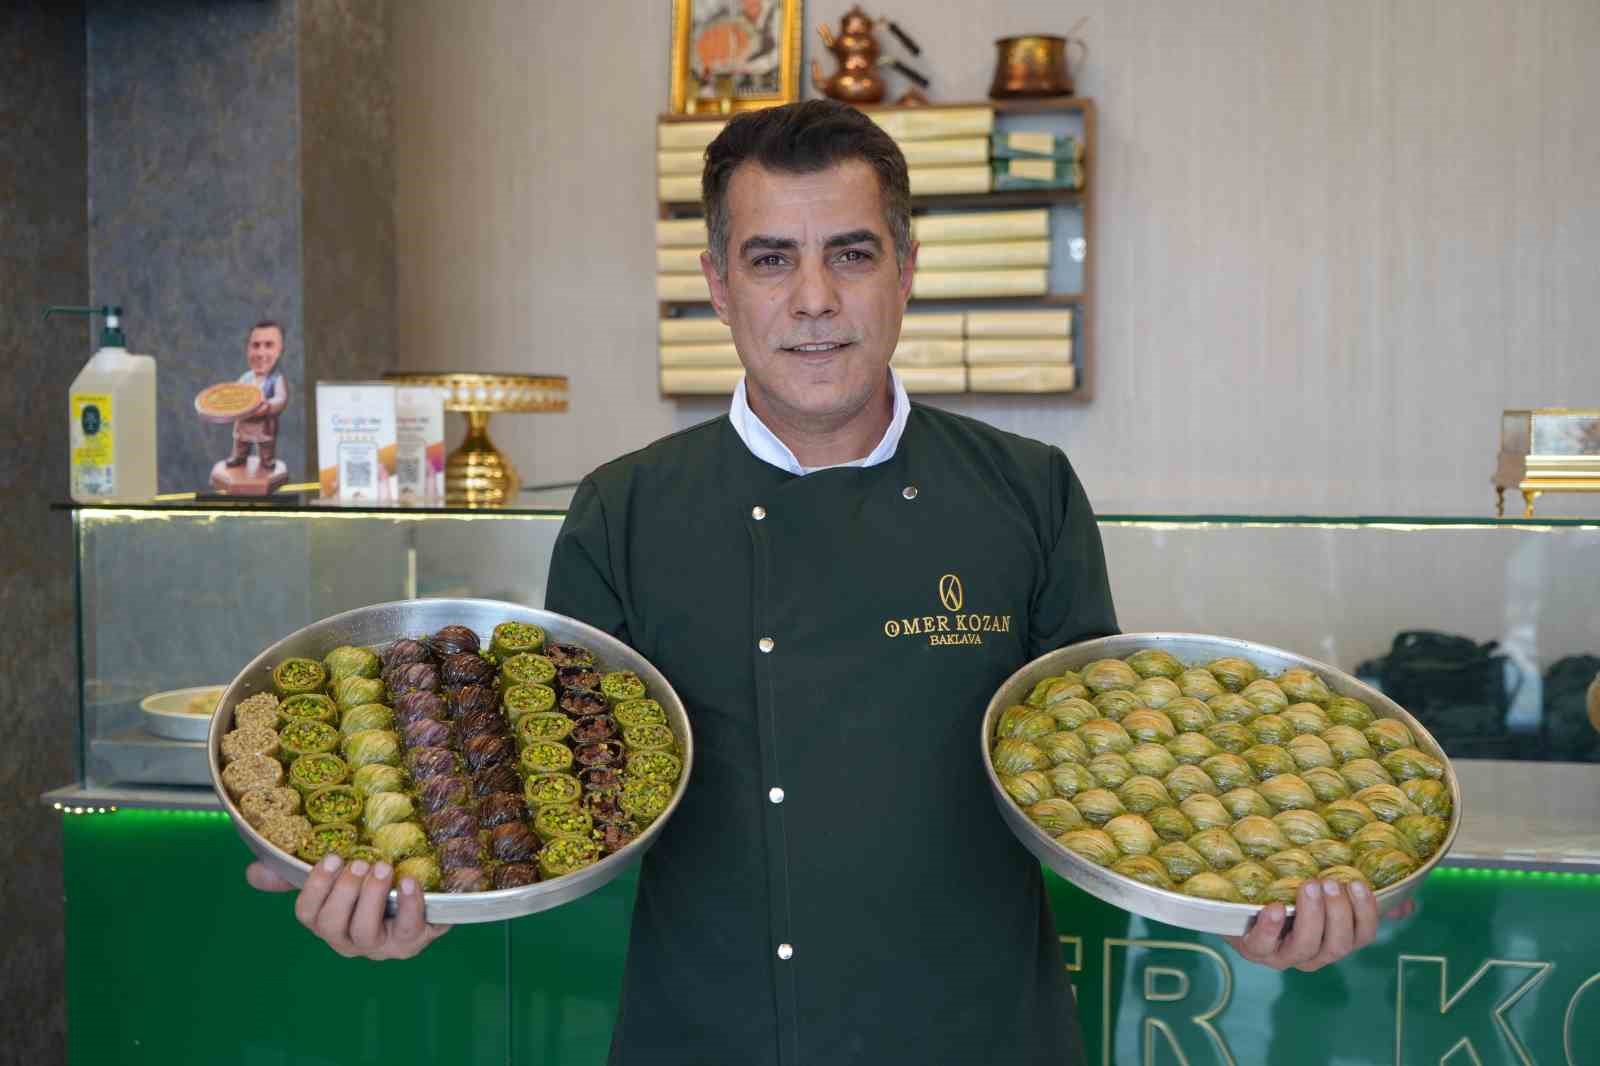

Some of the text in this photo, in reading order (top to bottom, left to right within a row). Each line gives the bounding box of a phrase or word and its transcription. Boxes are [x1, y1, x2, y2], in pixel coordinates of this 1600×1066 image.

[956, 614, 1011, 633] KOZAN
[930, 633, 982, 646] BAKLAVA
[1397, 954, 1600, 1066] K
